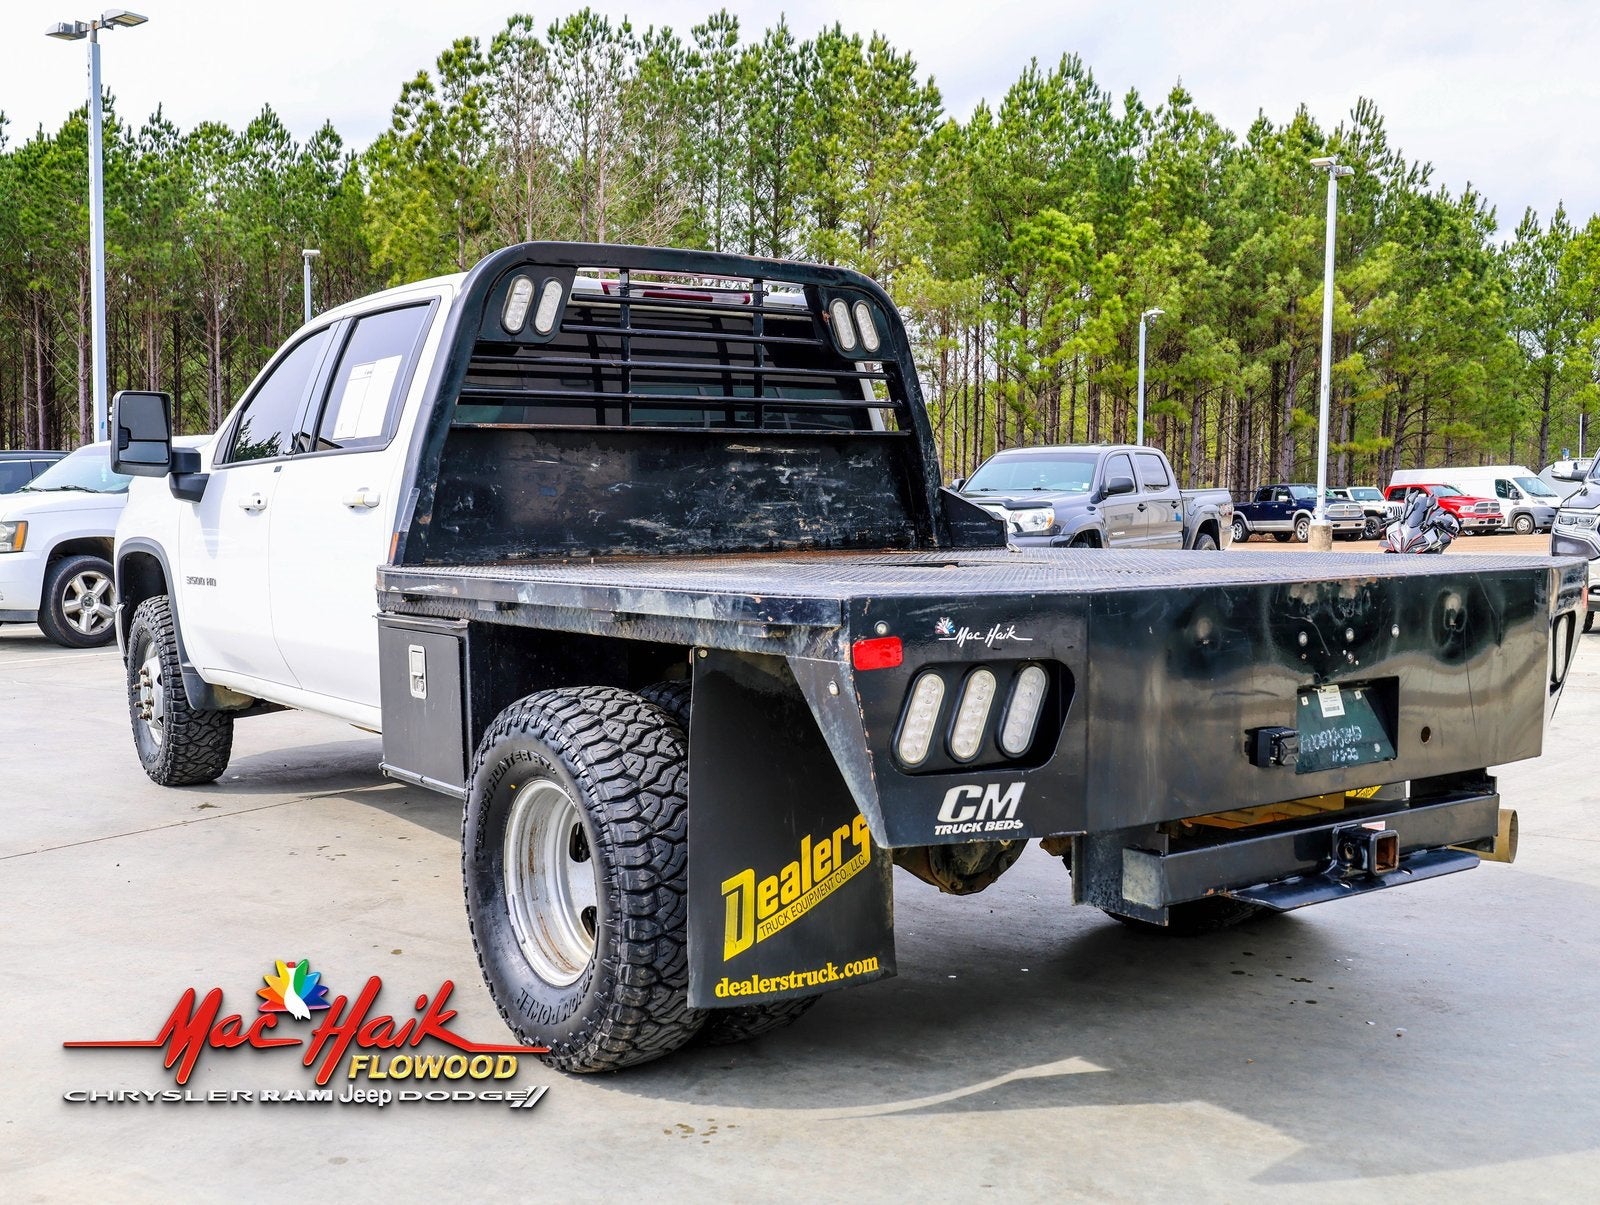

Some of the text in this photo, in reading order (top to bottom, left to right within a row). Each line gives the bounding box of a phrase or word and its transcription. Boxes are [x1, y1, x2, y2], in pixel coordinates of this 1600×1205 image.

[938, 623, 1033, 648] Mac Haik
[937, 781, 1026, 823] CM
[934, 819, 1024, 836] TRUCK BEDS
[721, 812, 871, 962] Dealers
[759, 910, 792, 937] TRUCK
[790, 876, 835, 919] EQUIPMENT
[714, 955, 880, 998] dealerstruck.com
